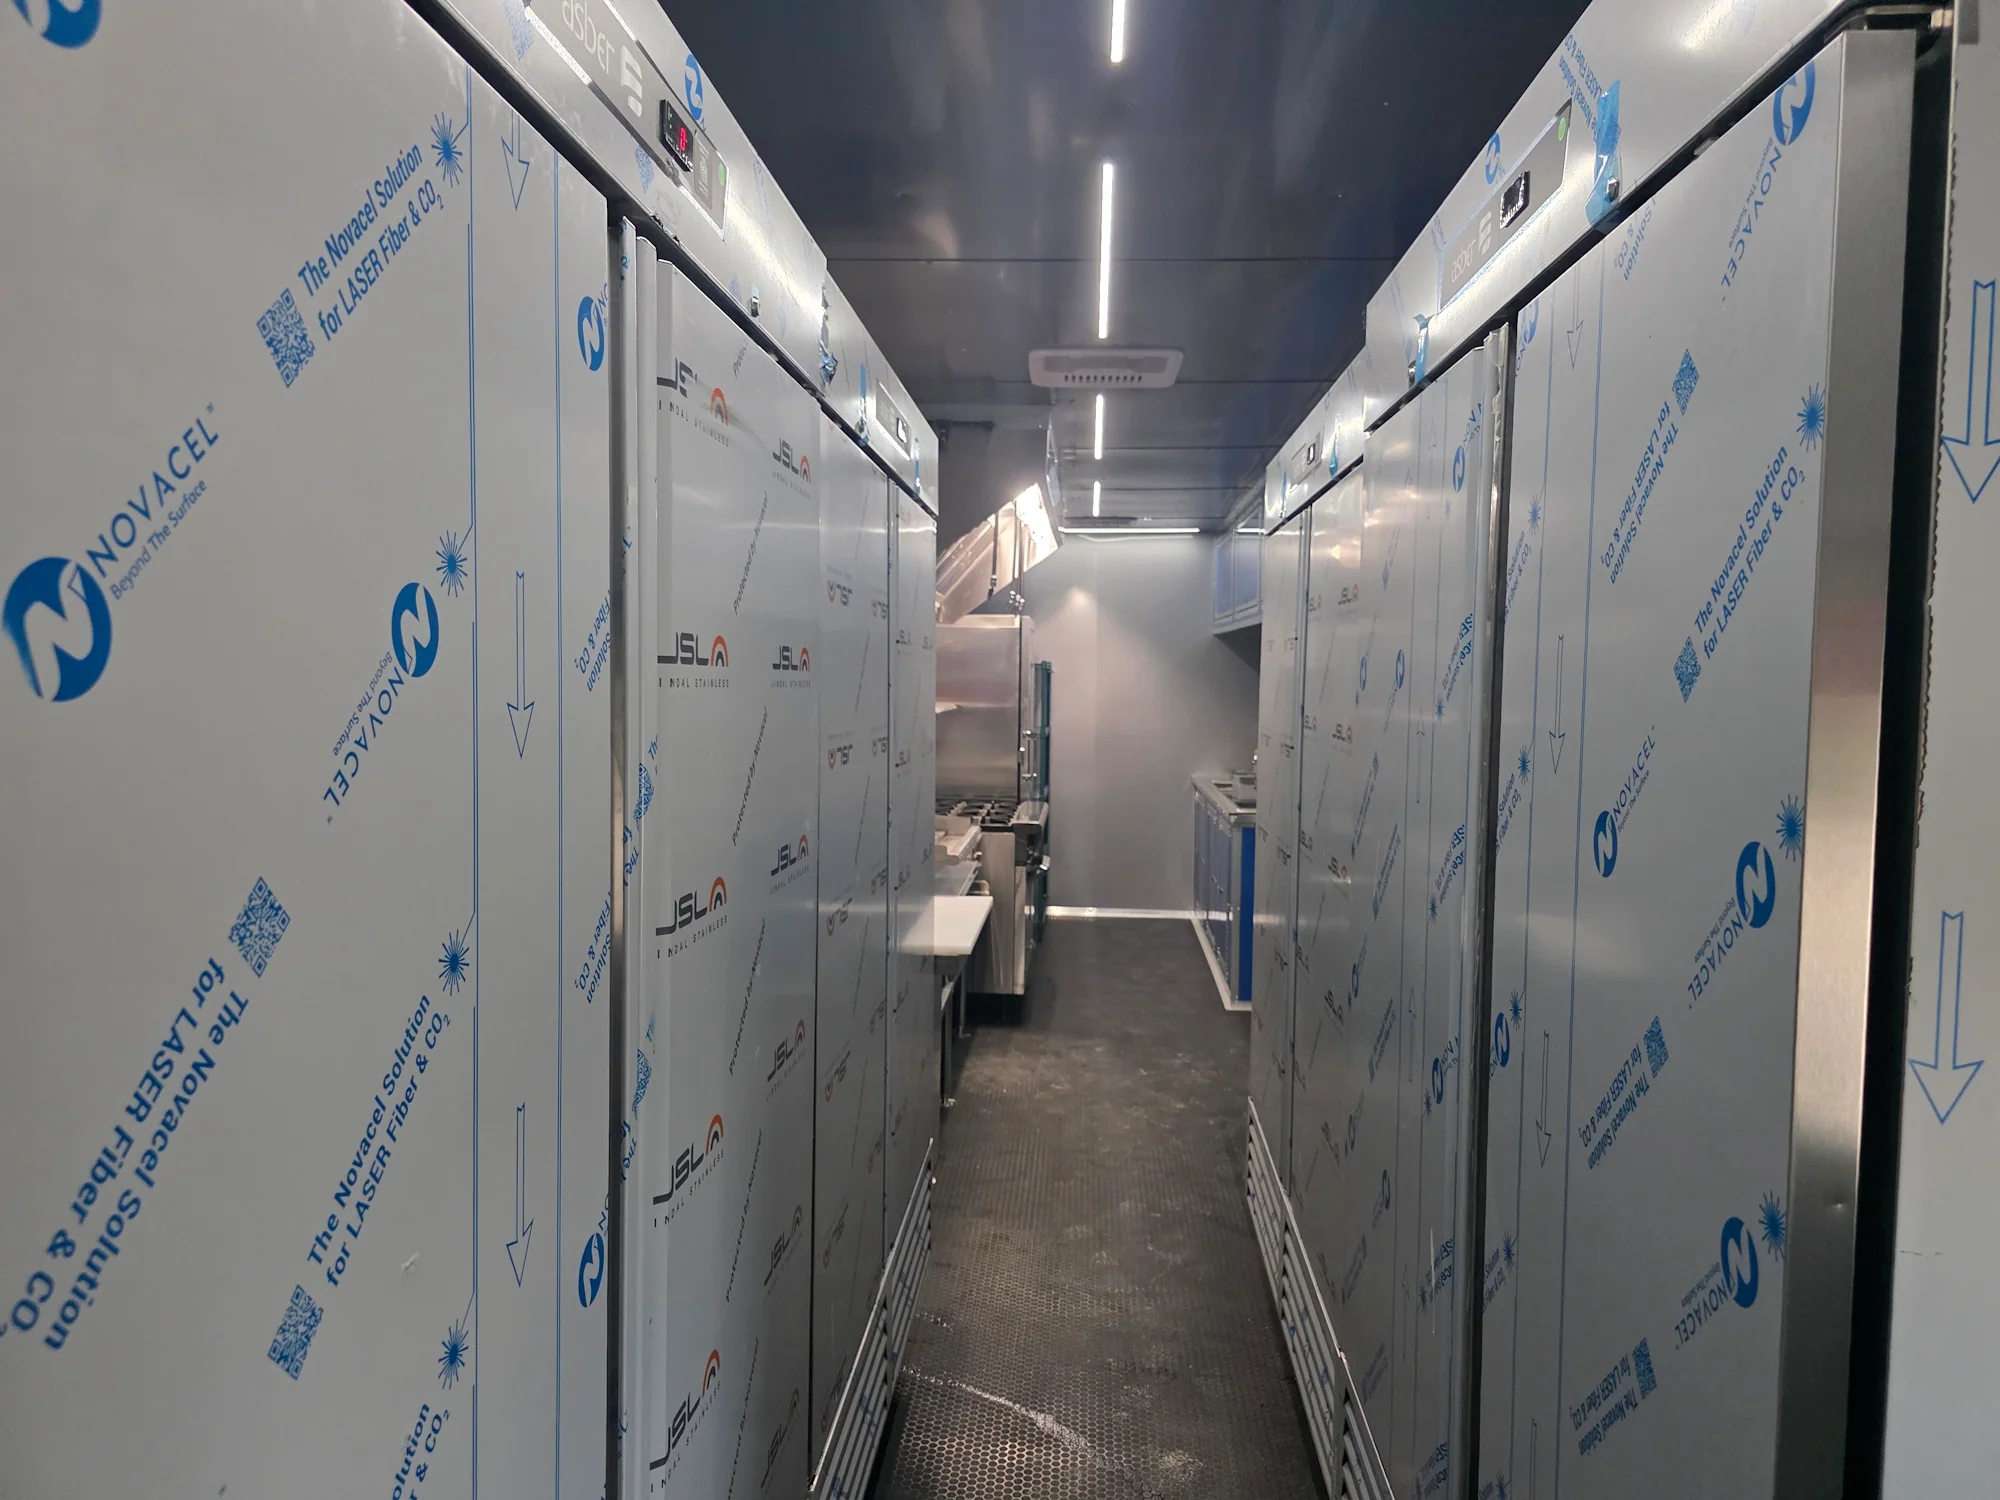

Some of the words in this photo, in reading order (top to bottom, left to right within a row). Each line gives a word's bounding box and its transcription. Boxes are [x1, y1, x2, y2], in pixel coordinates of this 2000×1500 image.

[297, 260, 330, 297] The
[324, 188, 379, 268] Novacel
[374, 144, 423, 208] Solution
[1624, 206, 1652, 280] Solution
[1721, 146, 1782, 287] NOVACEL
[318, 303, 343, 341] for
[338, 248, 384, 316] LASER
[378, 215, 411, 265] Fiber
[408, 200, 422, 227] &
[1658, 400, 1671, 431] for
[1662, 422, 1679, 455] The
[1635, 428, 1659, 488] LASER
[85, 417, 219, 578] NOVACEL
[1619, 485, 1637, 529] Fiber
[1636, 454, 1665, 526] Novacel
[110, 547, 151, 600] Beyond
[147, 523, 171, 551] The
[168, 480, 207, 528] Surface
[1610, 520, 1637, 584] Solution
[1694, 599, 1714, 634] The
[1710, 523, 1748, 603] Novacel
[1745, 446, 1788, 529] Solution
[1703, 630, 1718, 660] for
[1716, 568, 1749, 634] LASER
[1745, 520, 1773, 573] Fiber
[1771, 500, 1783, 522] &
[369, 651, 393, 694] Beyond
[657, 632, 709, 666] JSL
[772, 645, 799, 671] JSL
[356, 693, 373, 713] The
[694, 677, 729, 688] STAINLESS
[323, 666, 405, 806] NOVACEL
[332, 712, 360, 756] Surface
[1612, 735, 1656, 822] NOVACEL
[770, 842, 797, 877] JSL
[655, 889, 708, 936] JSL
[693, 914, 728, 943] STAINLESS
[192, 957, 226, 1008] for
[1687, 911, 1744, 1001] NOVACEL
[208, 989, 249, 1046] The
[125, 1006, 199, 1123] LASER
[1611, 1059, 1632, 1103] LASER
[1635, 1072, 1650, 1098] The
[134, 1047, 217, 1189] Novacel
[307, 1212, 339, 1265] The
[333, 1095, 387, 1209] Novacel
[382, 994, 430, 1096] Solution
[1610, 1091, 1637, 1140] Novacel
[70, 1124, 135, 1225] Fiber
[326, 1241, 351, 1288] for
[346, 1144, 391, 1240] LASER
[386, 1075, 418, 1143] Fiber
[415, 1053, 429, 1074] &
[653, 1142, 704, 1205] JSL
[689, 1149, 724, 1196] STAINLESS
[1587, 1127, 1613, 1170] Solution
[43, 1188, 142, 1351] Solution
[46, 1228, 77, 1260] &
[1674, 1277, 1730, 1346] NOVACEL
[650, 1392, 701, 1471] JSL
[415, 1462, 429, 1483] &
